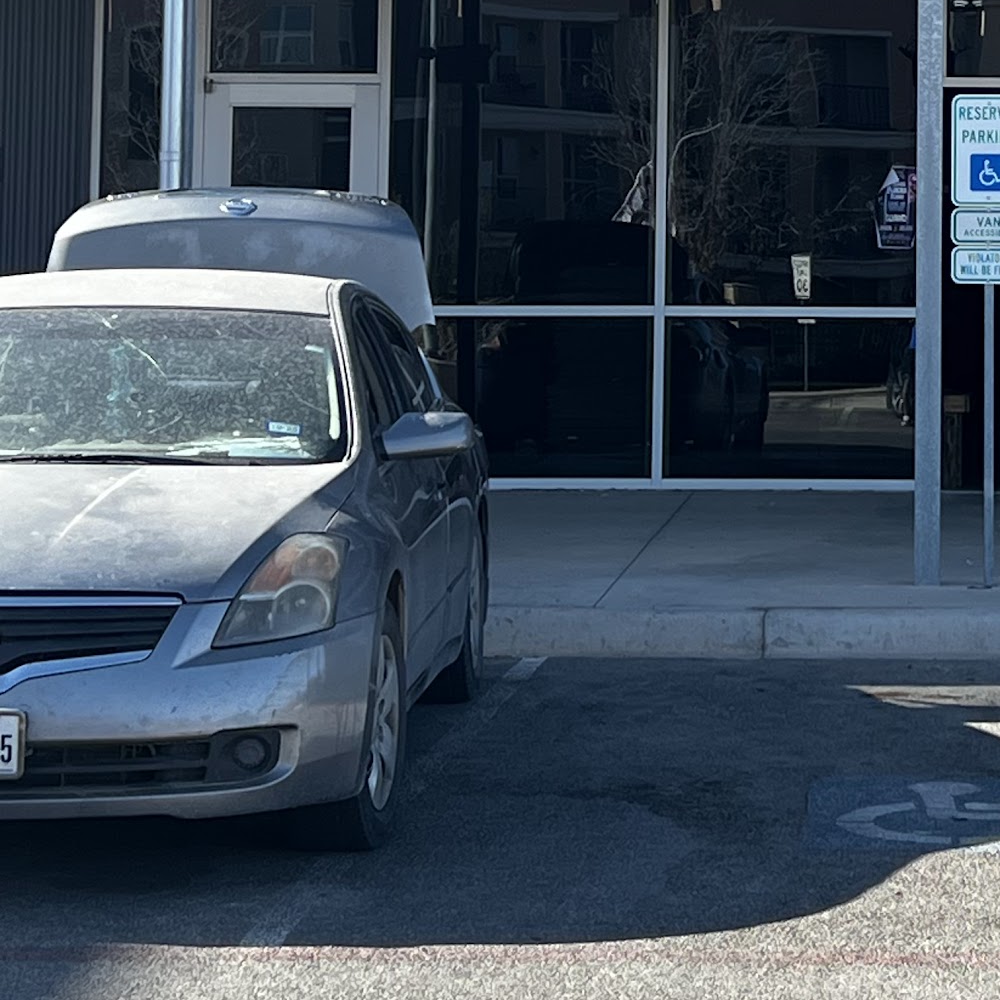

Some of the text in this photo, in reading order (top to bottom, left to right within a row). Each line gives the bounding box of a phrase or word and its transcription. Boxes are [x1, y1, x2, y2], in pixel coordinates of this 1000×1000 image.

[976, 216, 1000, 228] VAN
[960, 265, 979, 276] WILL
[981, 265, 991, 276] BE
